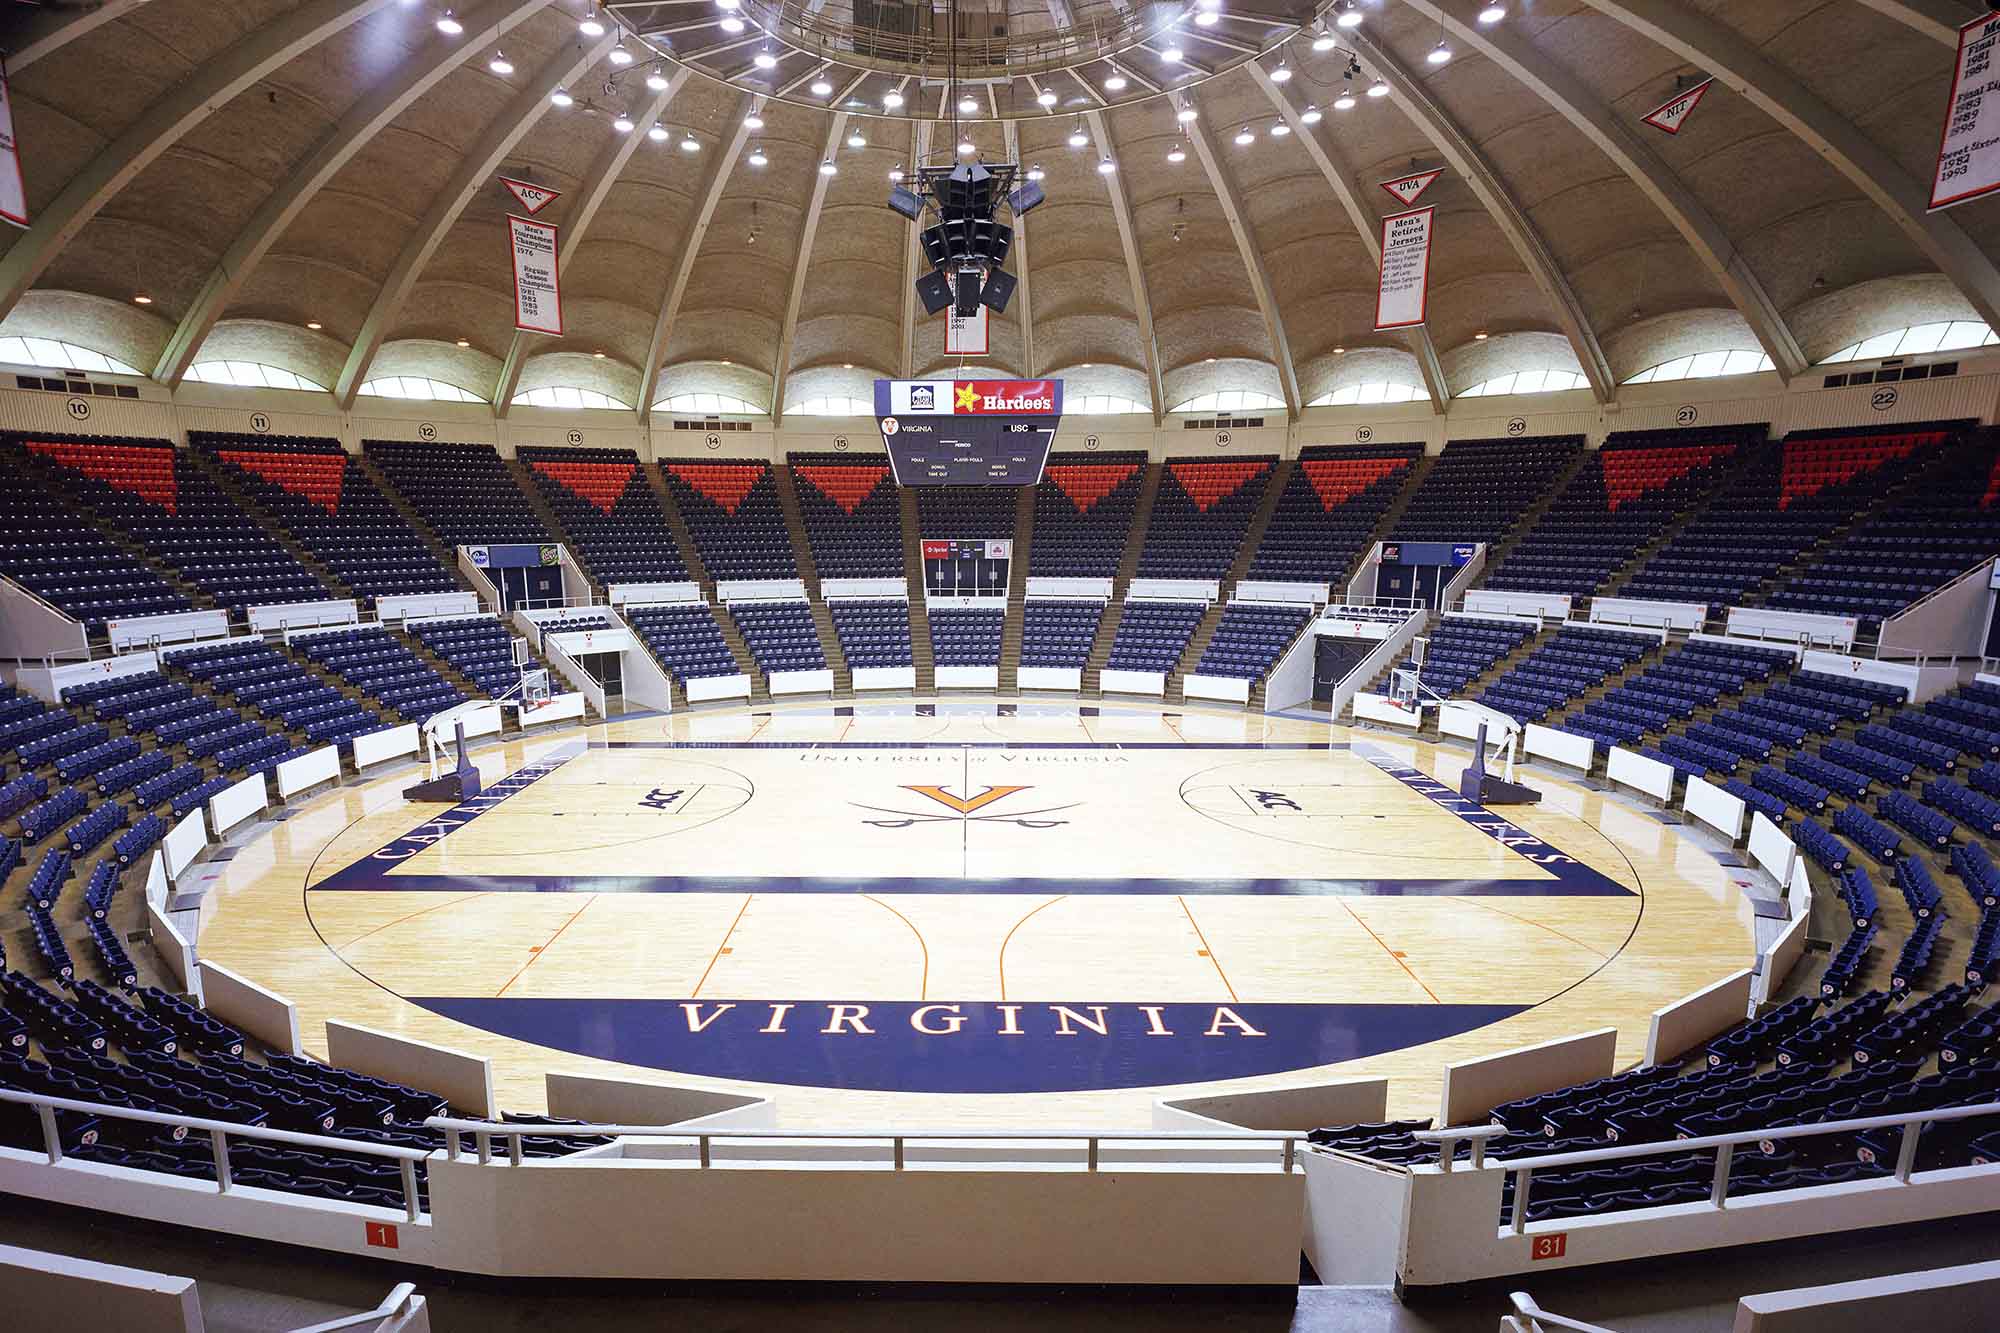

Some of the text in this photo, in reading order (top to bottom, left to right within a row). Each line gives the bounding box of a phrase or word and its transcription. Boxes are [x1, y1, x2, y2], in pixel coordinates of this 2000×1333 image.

[1968, 36, 1996, 57] Final
[1967, 50, 1989, 69] 1981
[1964, 60, 1990, 80] 1984
[1957, 86, 1984, 104] Final
[1667, 100, 1688, 119] NIT
[1955, 97, 1981, 115] 1983
[1941, 146, 1968, 161] Sweet
[1943, 154, 1970, 171] 1982
[1942, 165, 1968, 181] 1993
[1400, 180, 1420, 191] UVA
[520, 188, 543, 200] ACC
[1395, 217, 1421, 228] Men's
[1391, 225, 1424, 238] Retired
[1390, 235, 1424, 247] Jerseys
[517, 247, 534, 257] 1976
[983, 395, 1051, 410] Hardee's
[1874, 393, 1895, 405] 22
[70, 403, 88, 415] 10
[1679, 411, 1694, 421] 21
[254, 417, 266, 428] 11
[1010, 424, 1028, 432] USC
[1510, 423, 1525, 432] 20
[422, 427, 434, 437] 12
[569, 433, 582, 442] 13
[1359, 431, 1370, 439] 19
[708, 437, 719, 446] 14
[836, 439, 846, 447] 15
[1087, 438, 1097, 447] 17
[1217, 434, 1228, 443] 18
[638, 788, 685, 809] ACC
[679, 1003, 1266, 1036] VIRGINIA
[378, 1227, 386, 1245] 1
[1540, 1236, 1560, 1256] 31
